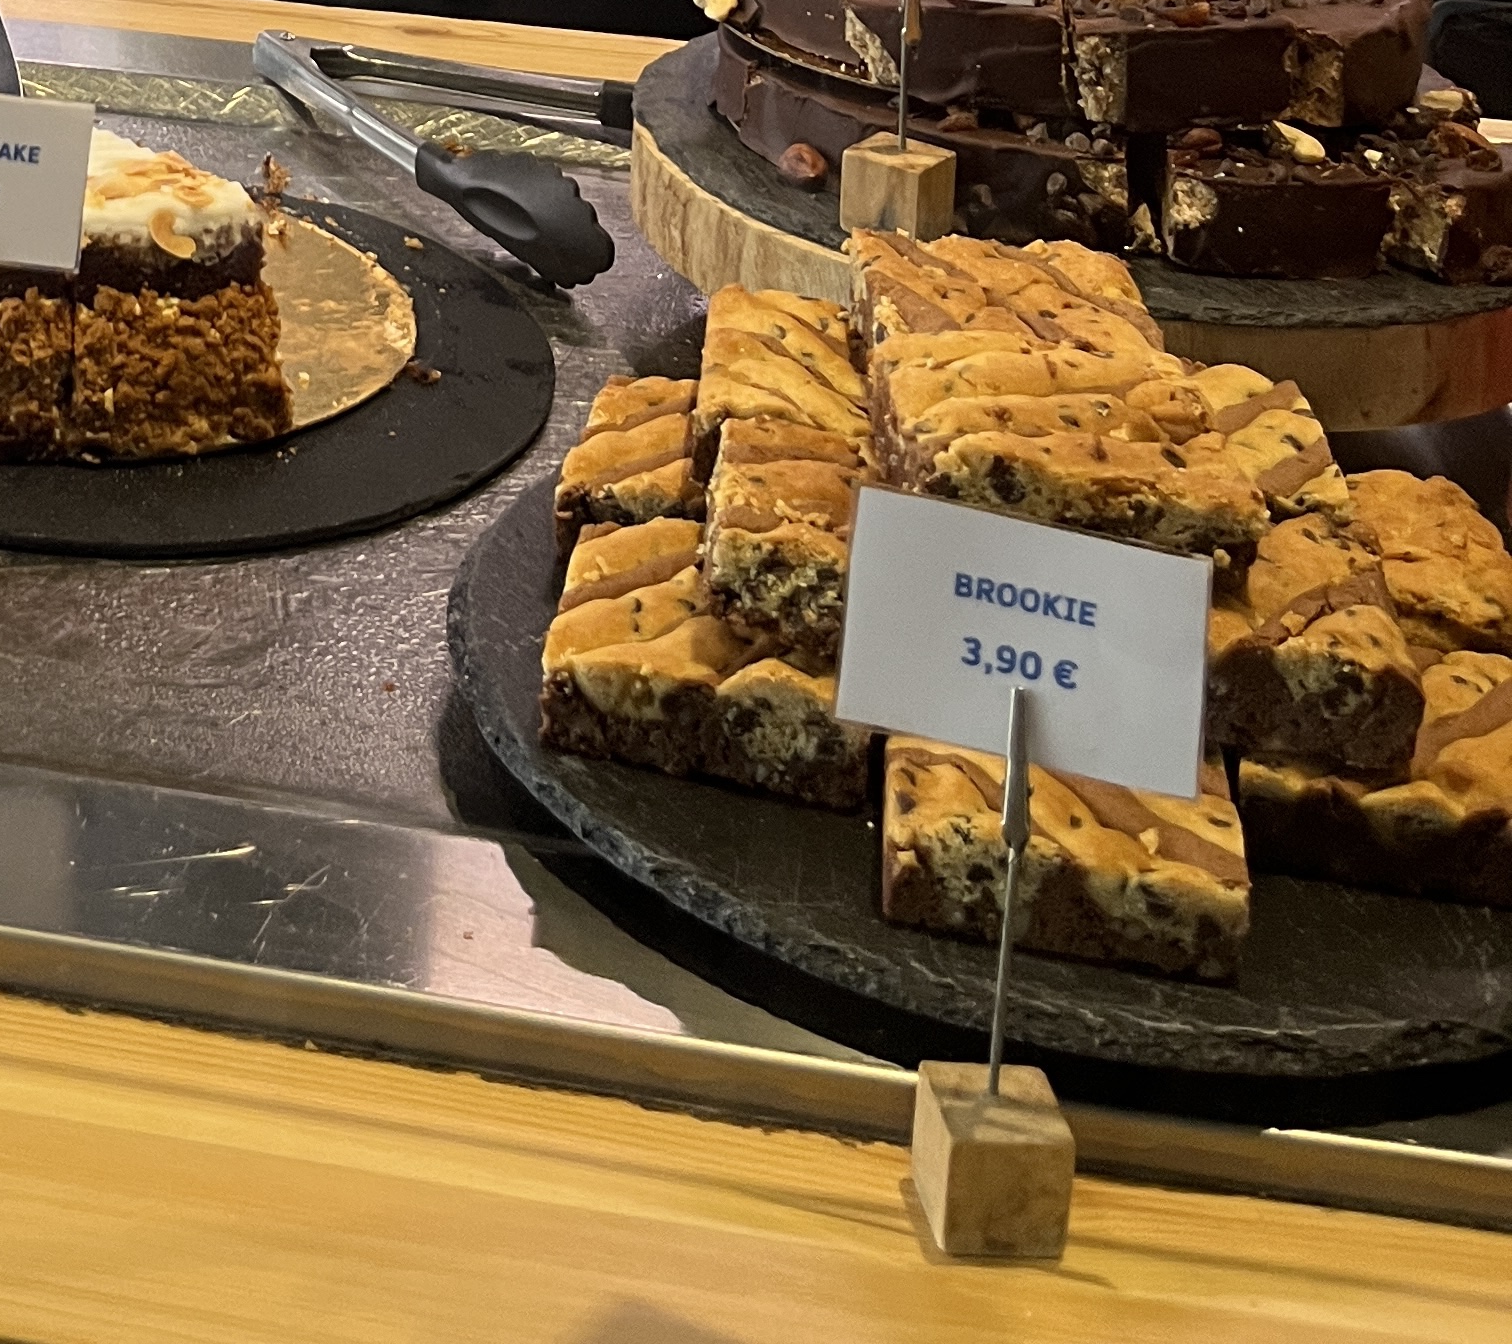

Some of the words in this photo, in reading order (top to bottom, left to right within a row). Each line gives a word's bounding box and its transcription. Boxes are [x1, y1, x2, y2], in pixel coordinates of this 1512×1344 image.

[954, 571, 1098, 627] BROOKIE
[960, 636, 1043, 681] 3,90
[1052, 659, 1079, 690] €
